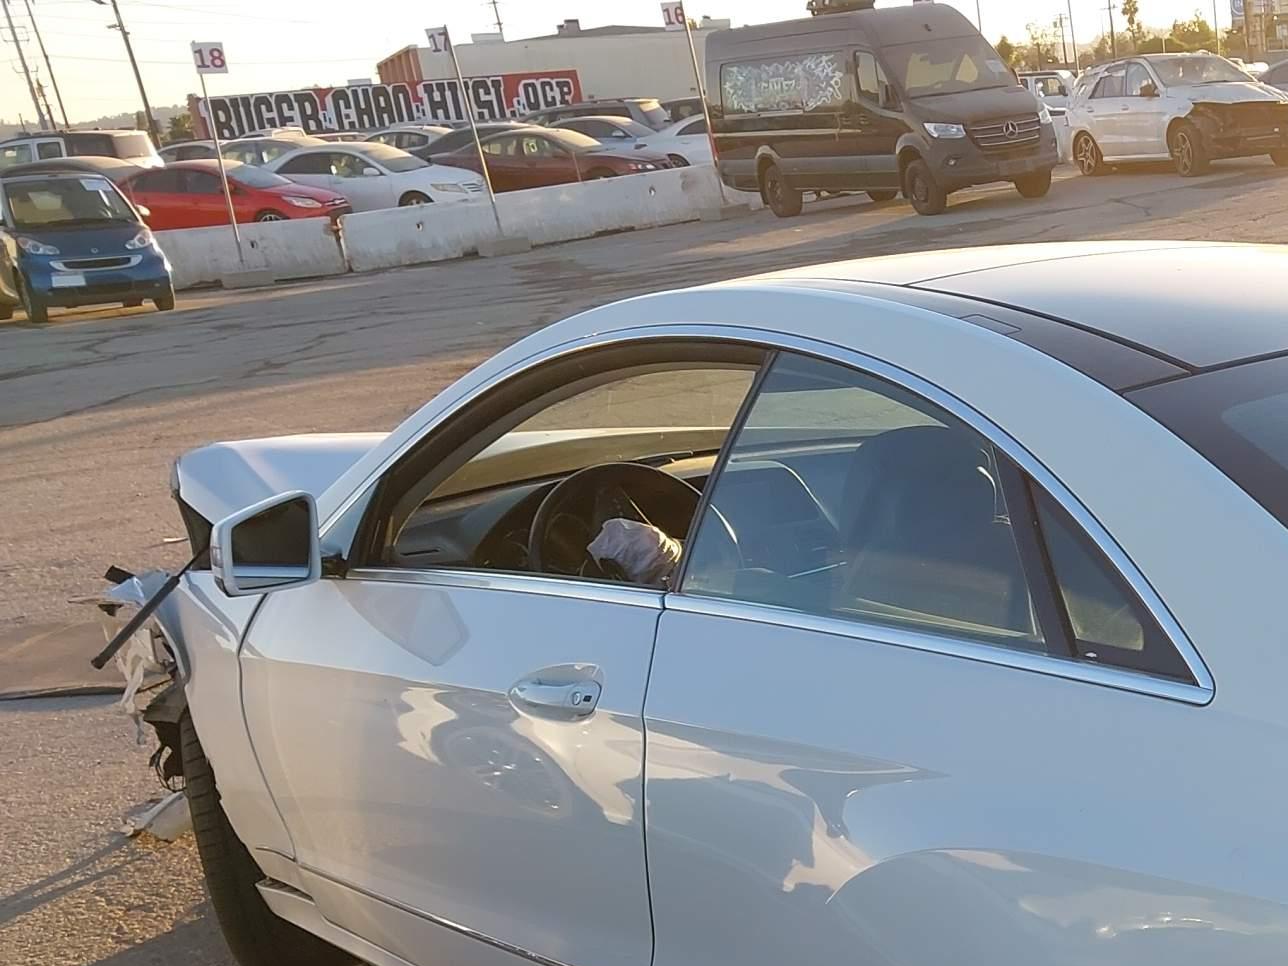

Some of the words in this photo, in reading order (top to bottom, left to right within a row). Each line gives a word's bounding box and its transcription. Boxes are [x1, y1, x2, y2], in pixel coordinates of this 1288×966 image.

[663, 6, 684, 25] 16
[428, 32, 449, 53] 17
[193, 47, 225, 68] 18
